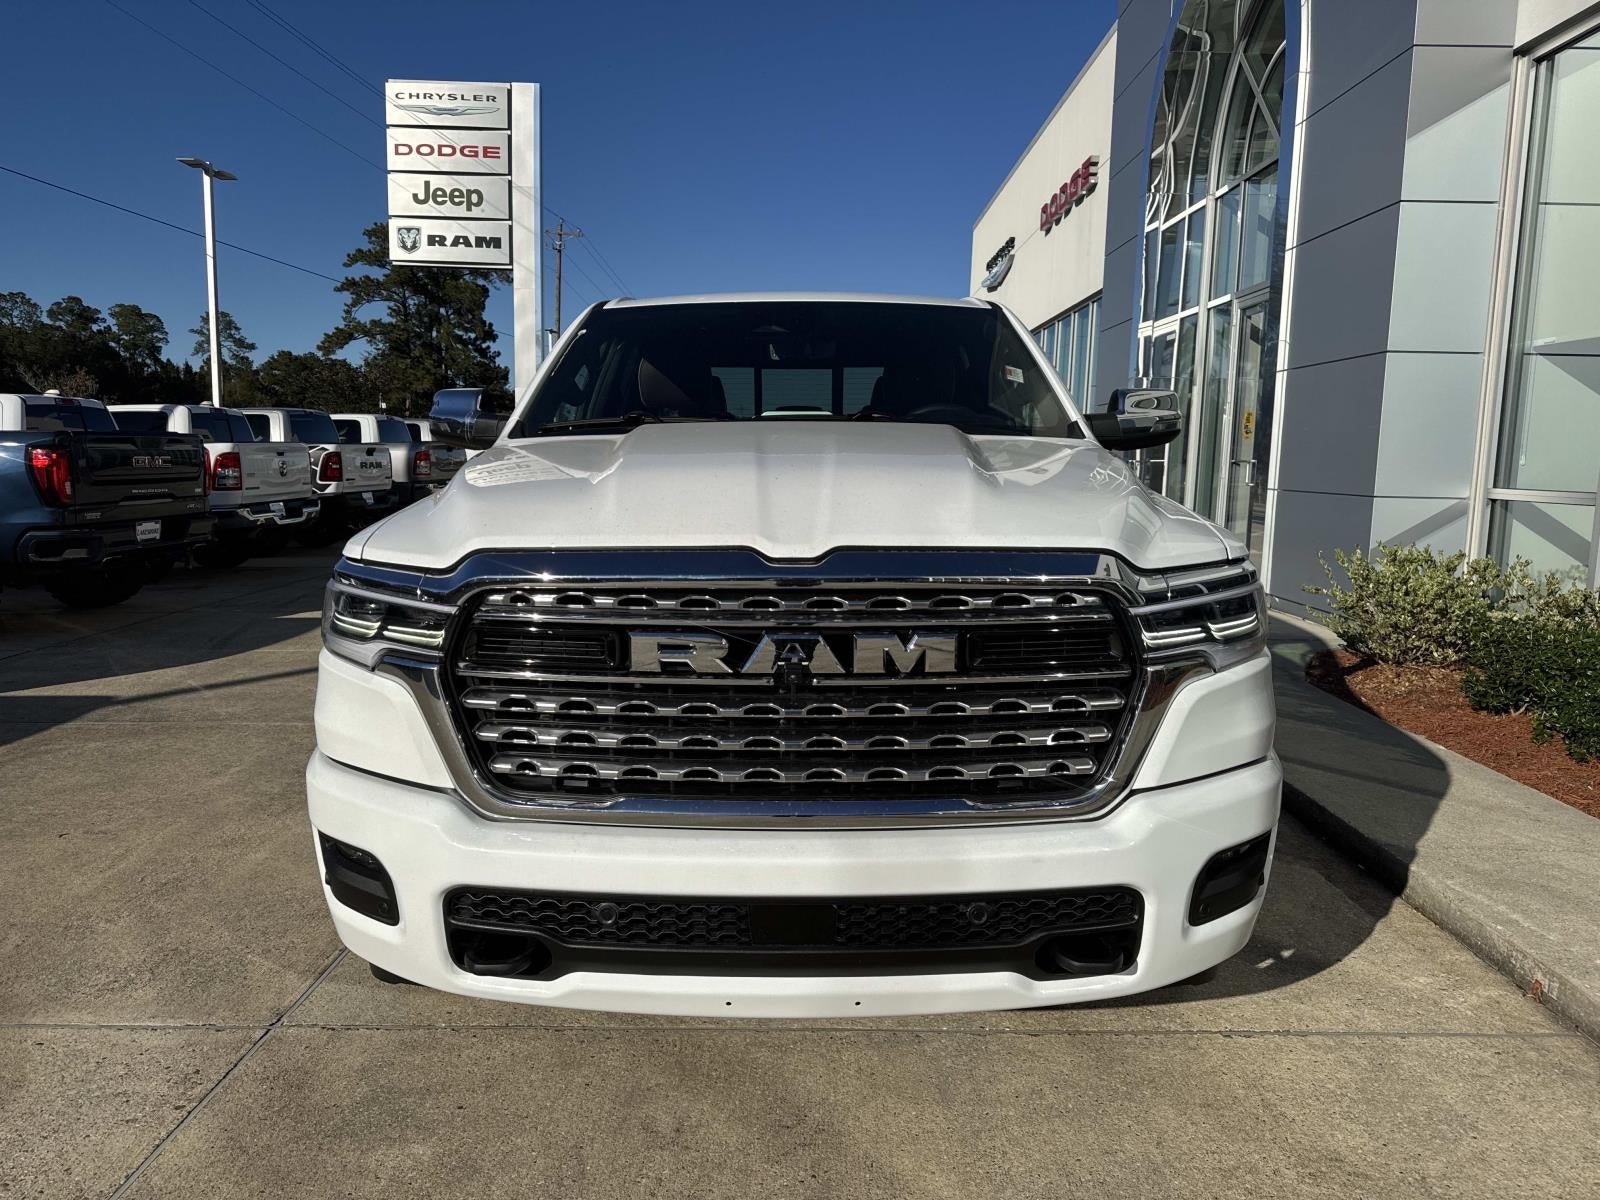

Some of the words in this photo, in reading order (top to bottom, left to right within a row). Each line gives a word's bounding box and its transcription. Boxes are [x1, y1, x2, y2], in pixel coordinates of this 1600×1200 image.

[395, 92, 497, 102] CHRYSLER
[394, 143, 501, 159] DODGE
[412, 180, 484, 212] Jeep
[1040, 155, 1100, 231] DODGE
[427, 234, 502, 249] RAM
[132, 455, 172, 468] GMC
[360, 461, 383, 469] RAM
[630, 631, 957, 674] RAM
